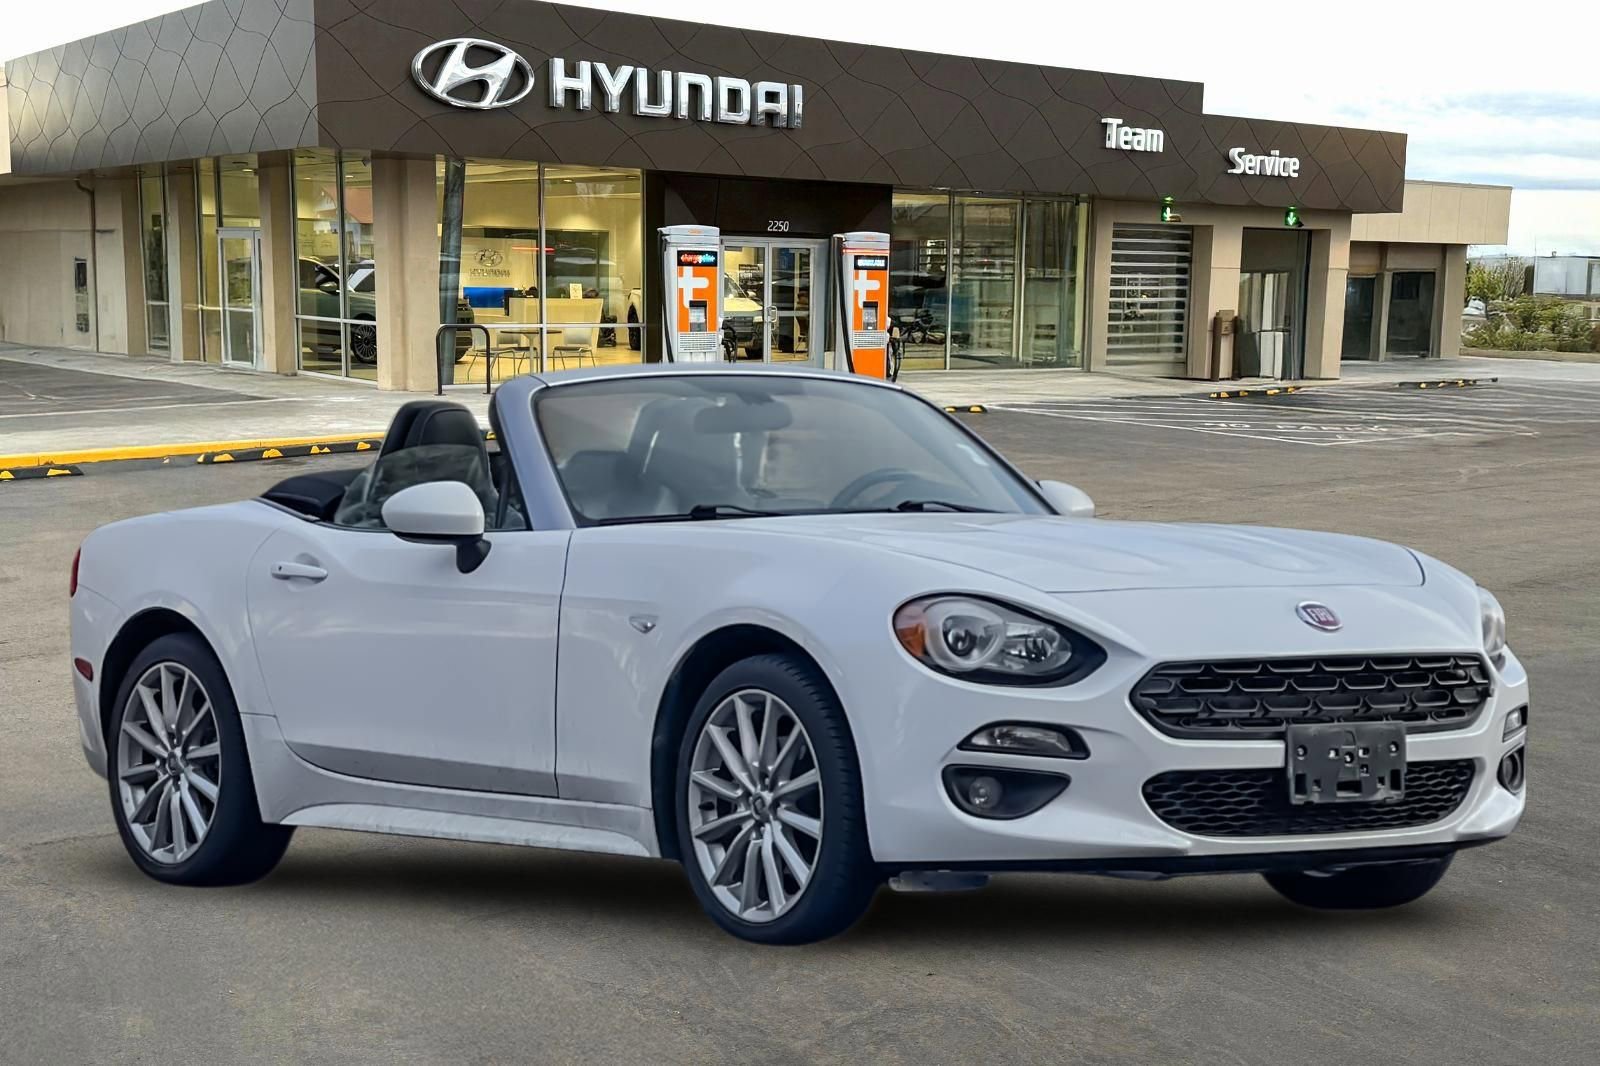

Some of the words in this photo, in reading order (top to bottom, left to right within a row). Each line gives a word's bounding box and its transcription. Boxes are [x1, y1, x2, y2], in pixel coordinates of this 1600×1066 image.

[548, 57, 803, 129] HYUNDAI
[1101, 117, 1164, 153] Team
[1227, 147, 1300, 178] Service
[767, 220, 790, 232] 2250
